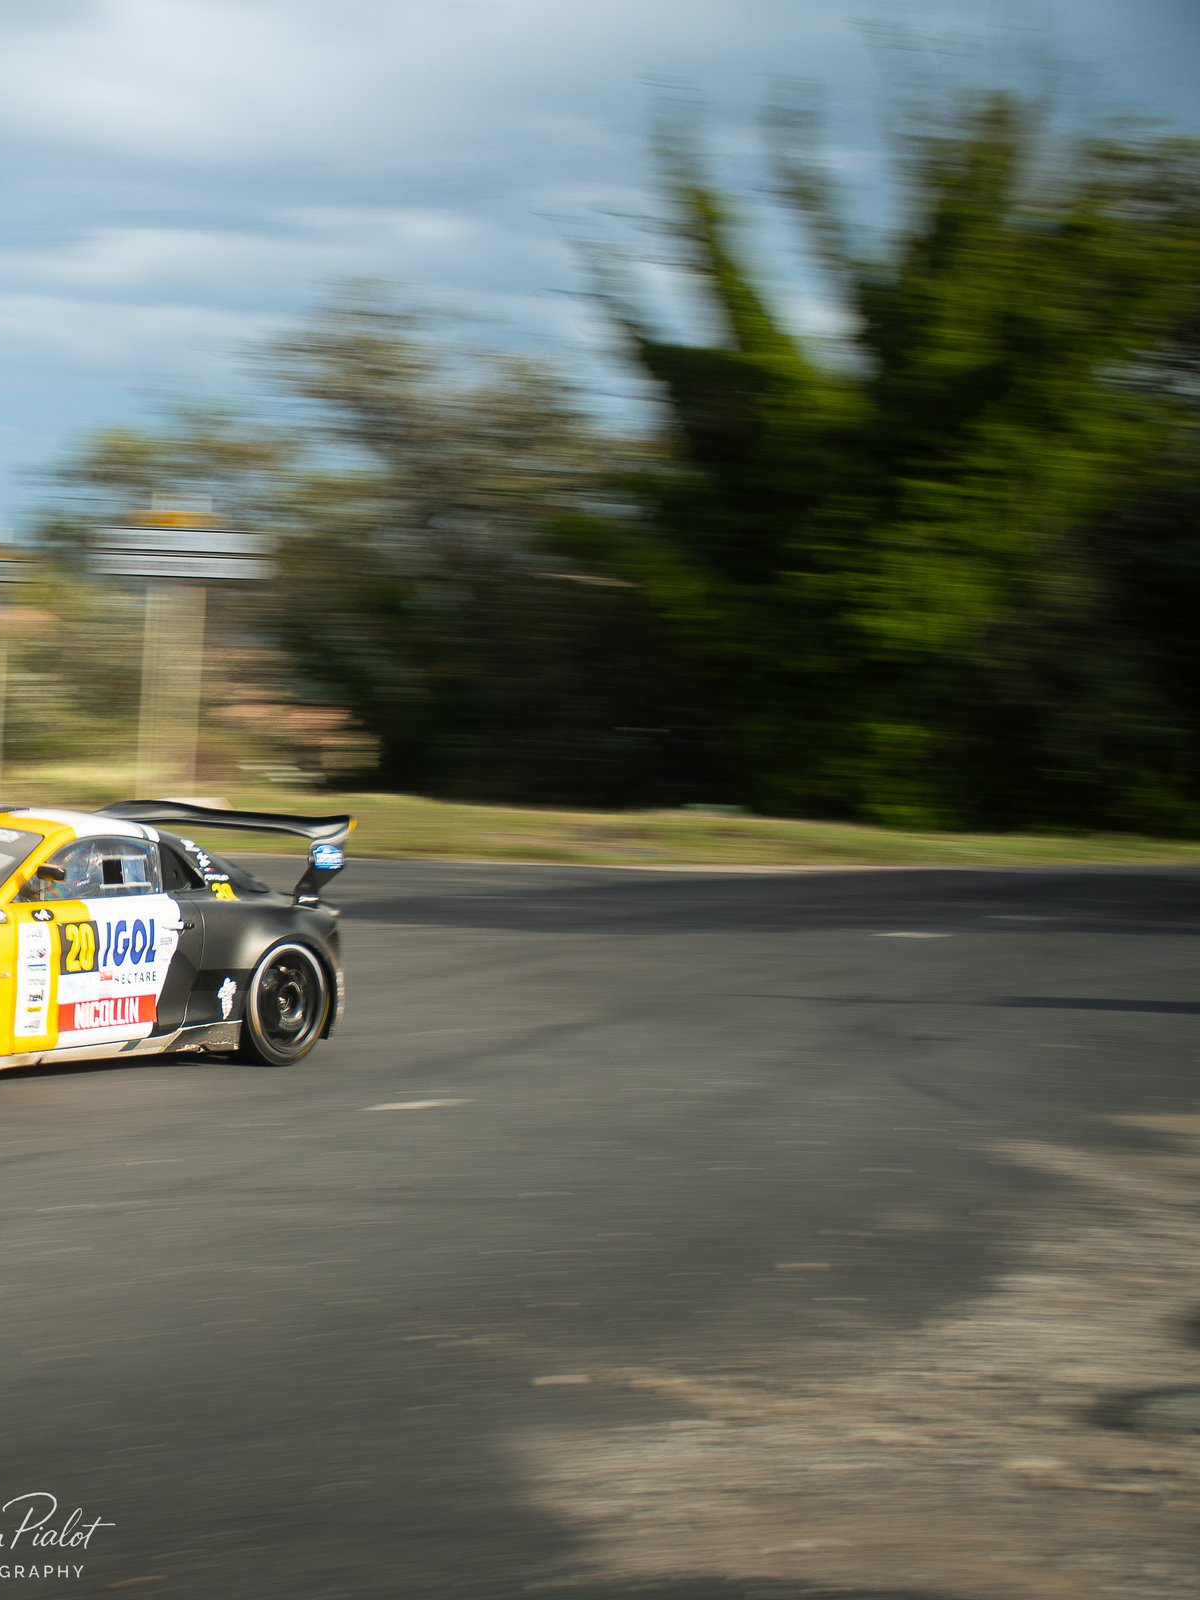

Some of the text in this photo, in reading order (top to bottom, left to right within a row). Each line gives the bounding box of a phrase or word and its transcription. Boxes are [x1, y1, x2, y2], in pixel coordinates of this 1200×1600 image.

[65, 922, 96, 973] 20
[102, 918, 157, 967] IGOL
[73, 996, 140, 1030] NICOLLIN
